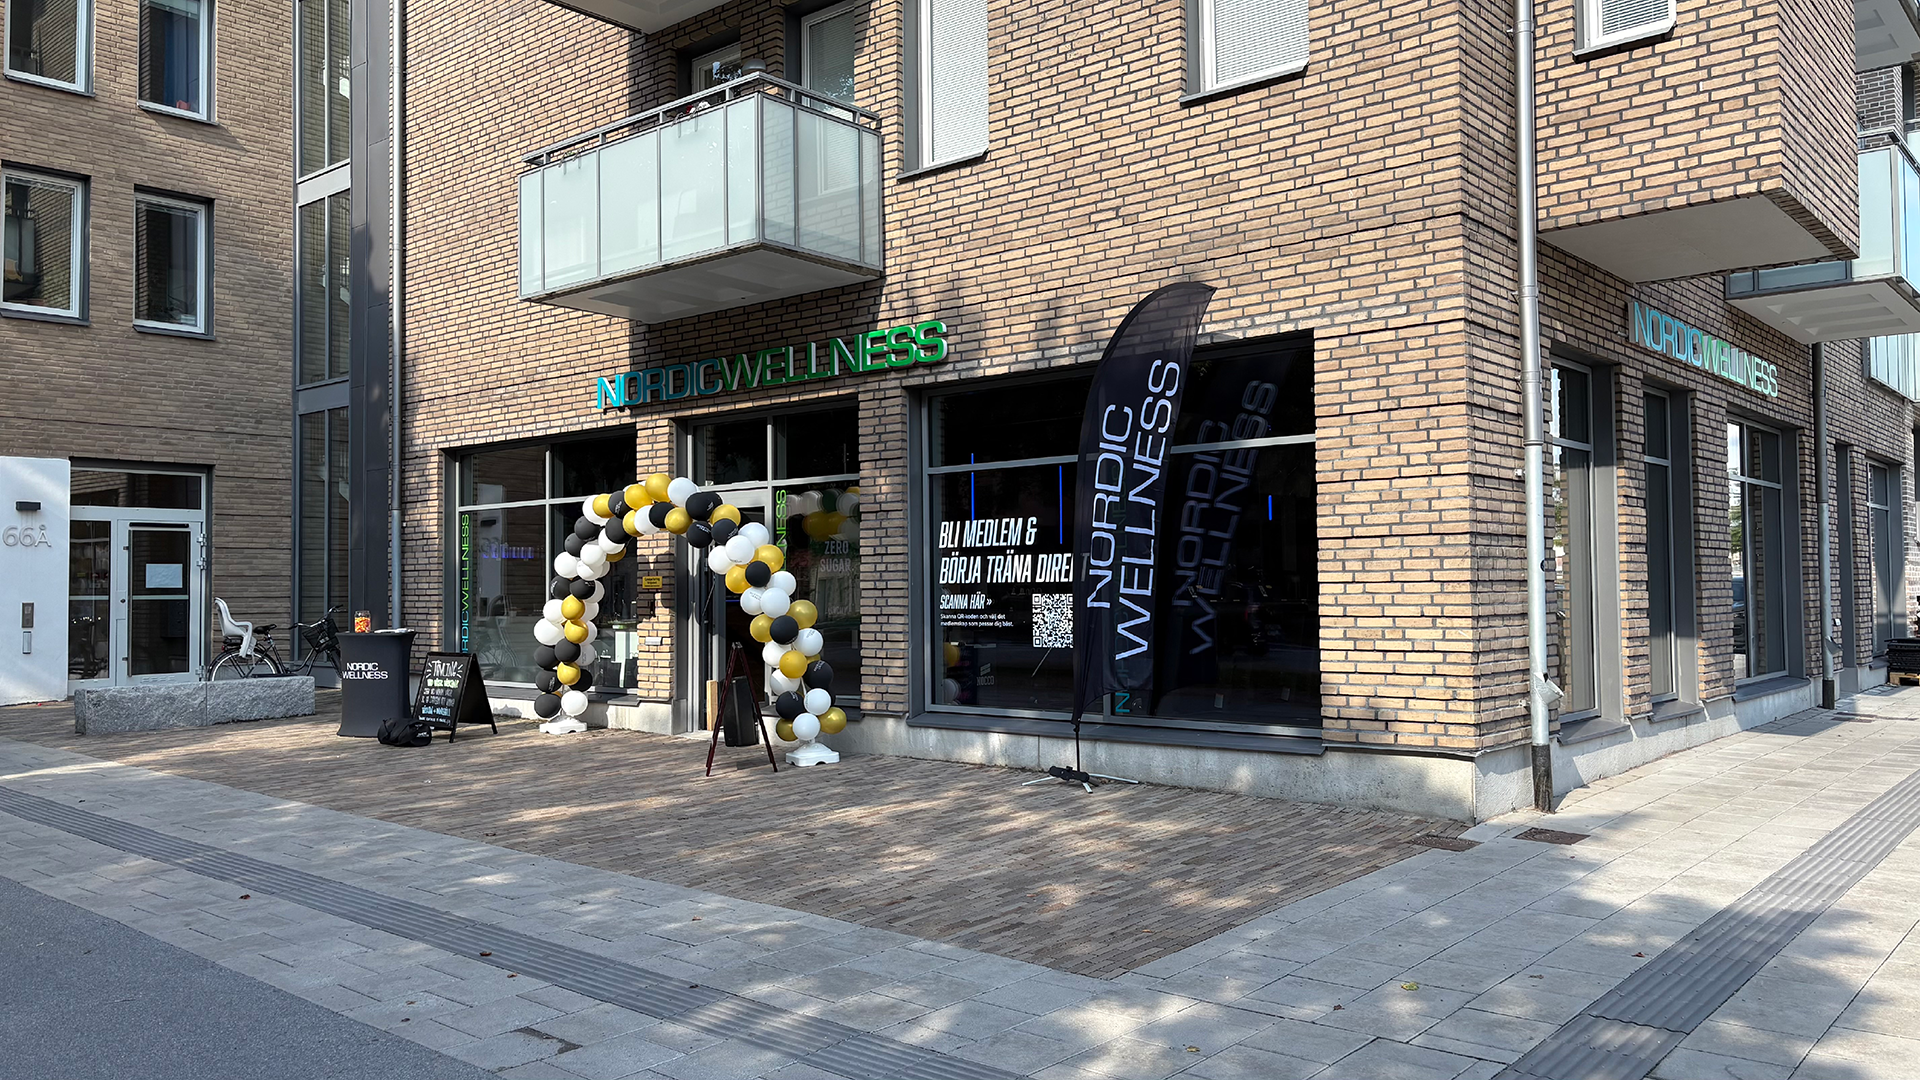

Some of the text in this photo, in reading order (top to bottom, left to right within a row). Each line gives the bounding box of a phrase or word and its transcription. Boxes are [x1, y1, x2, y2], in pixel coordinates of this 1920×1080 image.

[596, 320, 948, 409] NORDICWELLNESS
[1631, 301, 1778, 398] NORDICWELLNESS
[1087, 404, 1134, 609] NORDIC
[1115, 358, 1181, 661] WELLNESS
[2, 524, 52, 548] 66Å
[824, 540, 849, 554] ZERO
[939, 516, 1038, 549] BLI MEDLEM &
[939, 552, 981, 584] BÖRJA
[986, 549, 1032, 583] TRÄNA
[940, 591, 986, 610] SCANNA HÄR
[342, 671, 388, 680] WELLNESS
[346, 662, 379, 671] NORDIC
